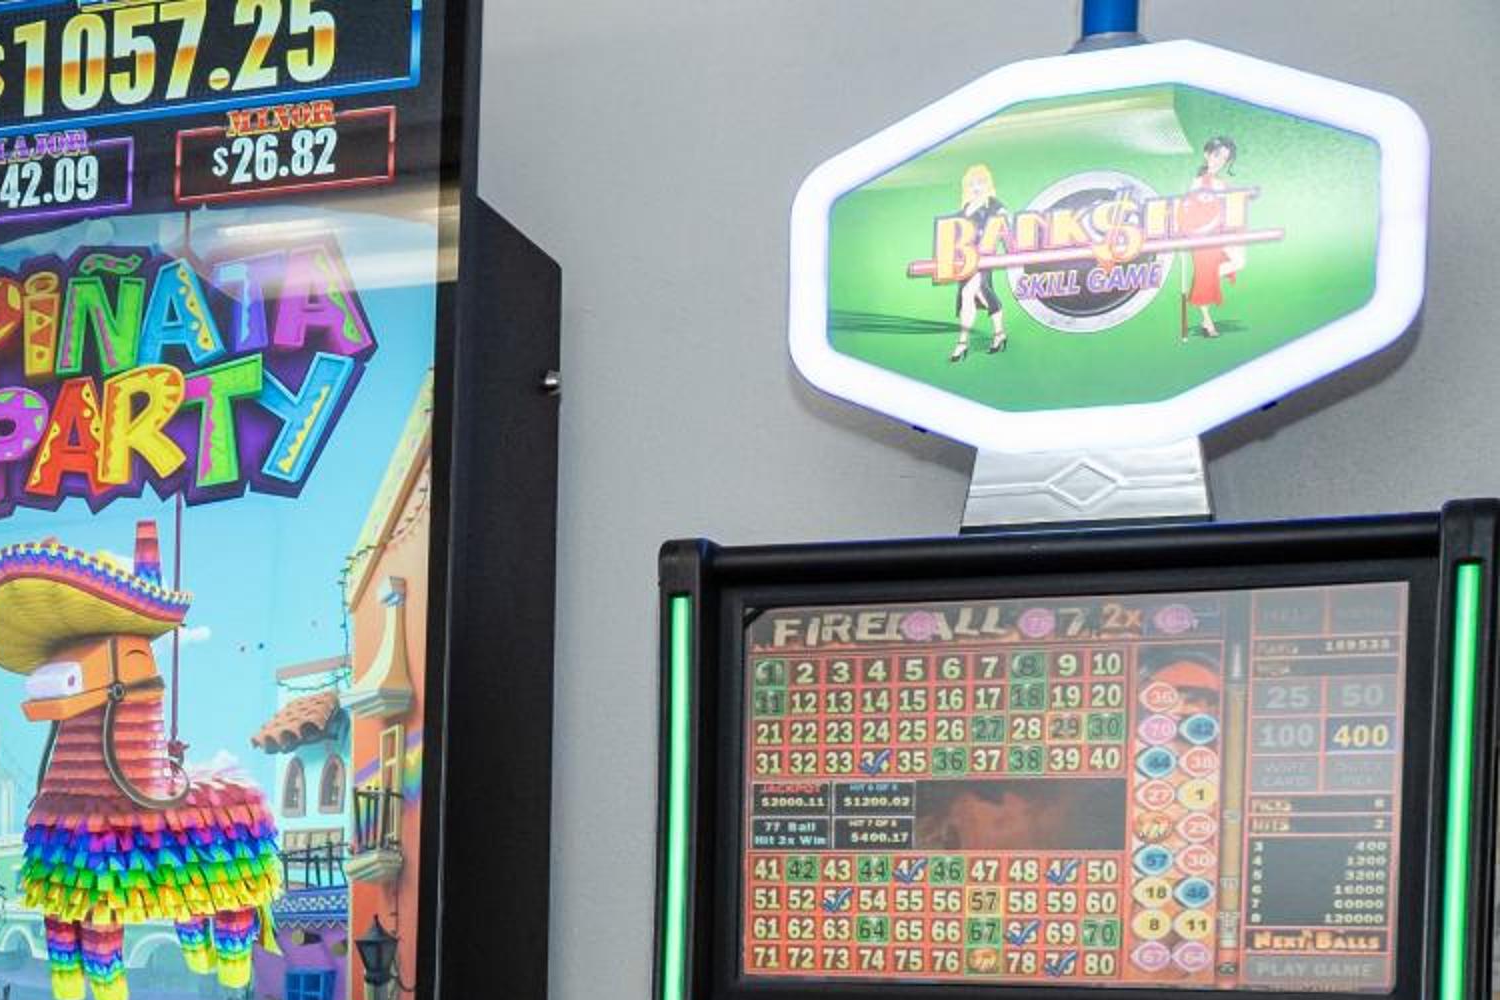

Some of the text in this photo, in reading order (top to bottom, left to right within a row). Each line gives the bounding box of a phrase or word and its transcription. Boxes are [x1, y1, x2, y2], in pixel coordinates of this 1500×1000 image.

[226, 99, 336, 136] MINOR
[212, 129, 337, 185] $26.82
[1015, 263, 1163, 299] SKILL GAME
[796, 653, 1121, 684] 2 3 4 5 6 7 9 10
[791, 683, 1122, 713] 12 13 14 15 16 17 19 20
[1266, 684, 1384, 709] 25 50
[756, 717, 1041, 745] 21 22 23 24 25 26 28
[1258, 722, 1390, 748] 100 400
[755, 750, 927, 774] 31 32 33 35
[764, 821, 816, 832] 77 Ball
[755, 835, 775, 845] Hit
[799, 835, 827, 845] Win
[1354, 841, 1387, 851] 400
[1252, 856, 1386, 867] 4 1200
[1185, 919, 1207, 931] 11
[1315, 931, 1381, 950] BALLS
